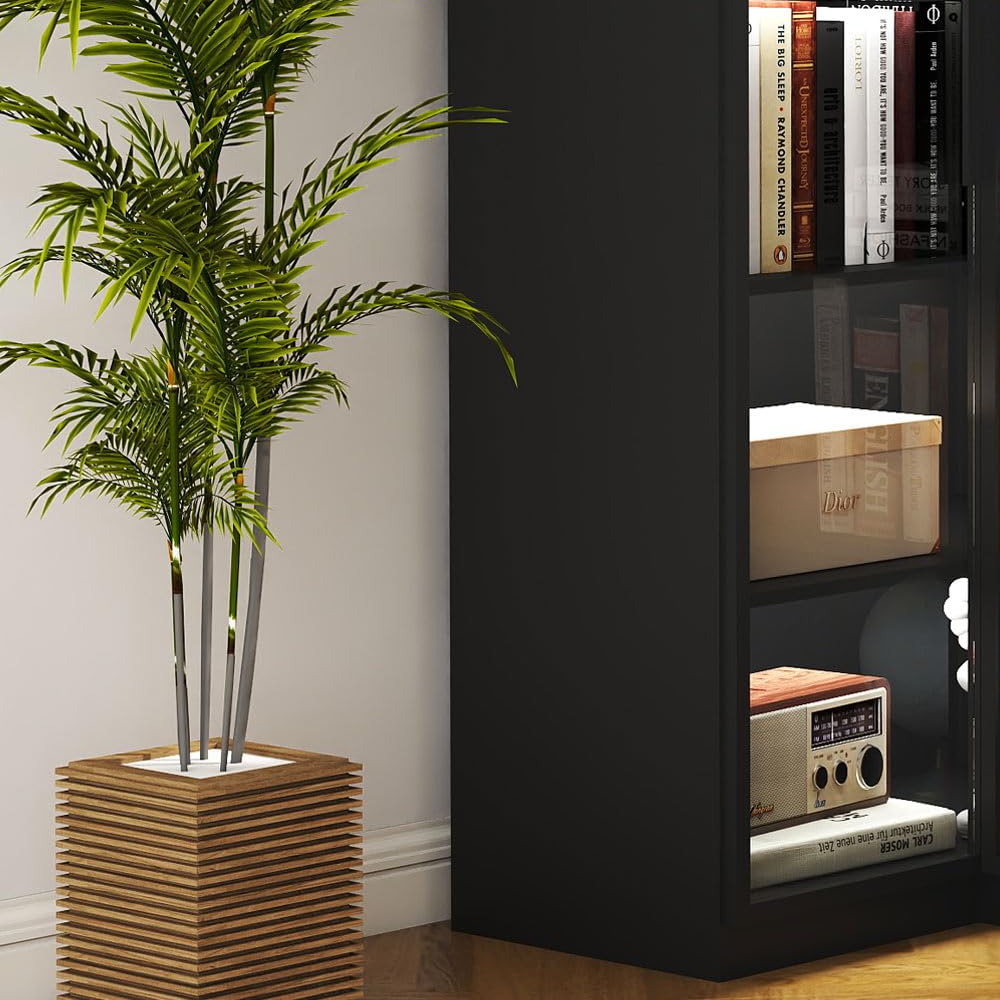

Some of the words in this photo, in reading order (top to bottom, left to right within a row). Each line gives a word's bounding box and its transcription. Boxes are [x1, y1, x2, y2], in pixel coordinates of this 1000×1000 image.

[777, 25, 785, 44] THE
[777, 48, 785, 67] BIG
[777, 72, 785, 102] SLEEP
[777, 117, 785, 174] RAYMOND
[777, 178, 785, 237] CHANDLER
[822, 488, 861, 514] Dior
[857, 833, 874, 845] eine
[875, 829, 889, 843] für
[889, 821, 934, 839] Architektur
[818, 840, 834, 853] Zeit
[836, 836, 856, 847] neue
[879, 839, 910, 854] MOSER
[911, 834, 934, 849] CARL
